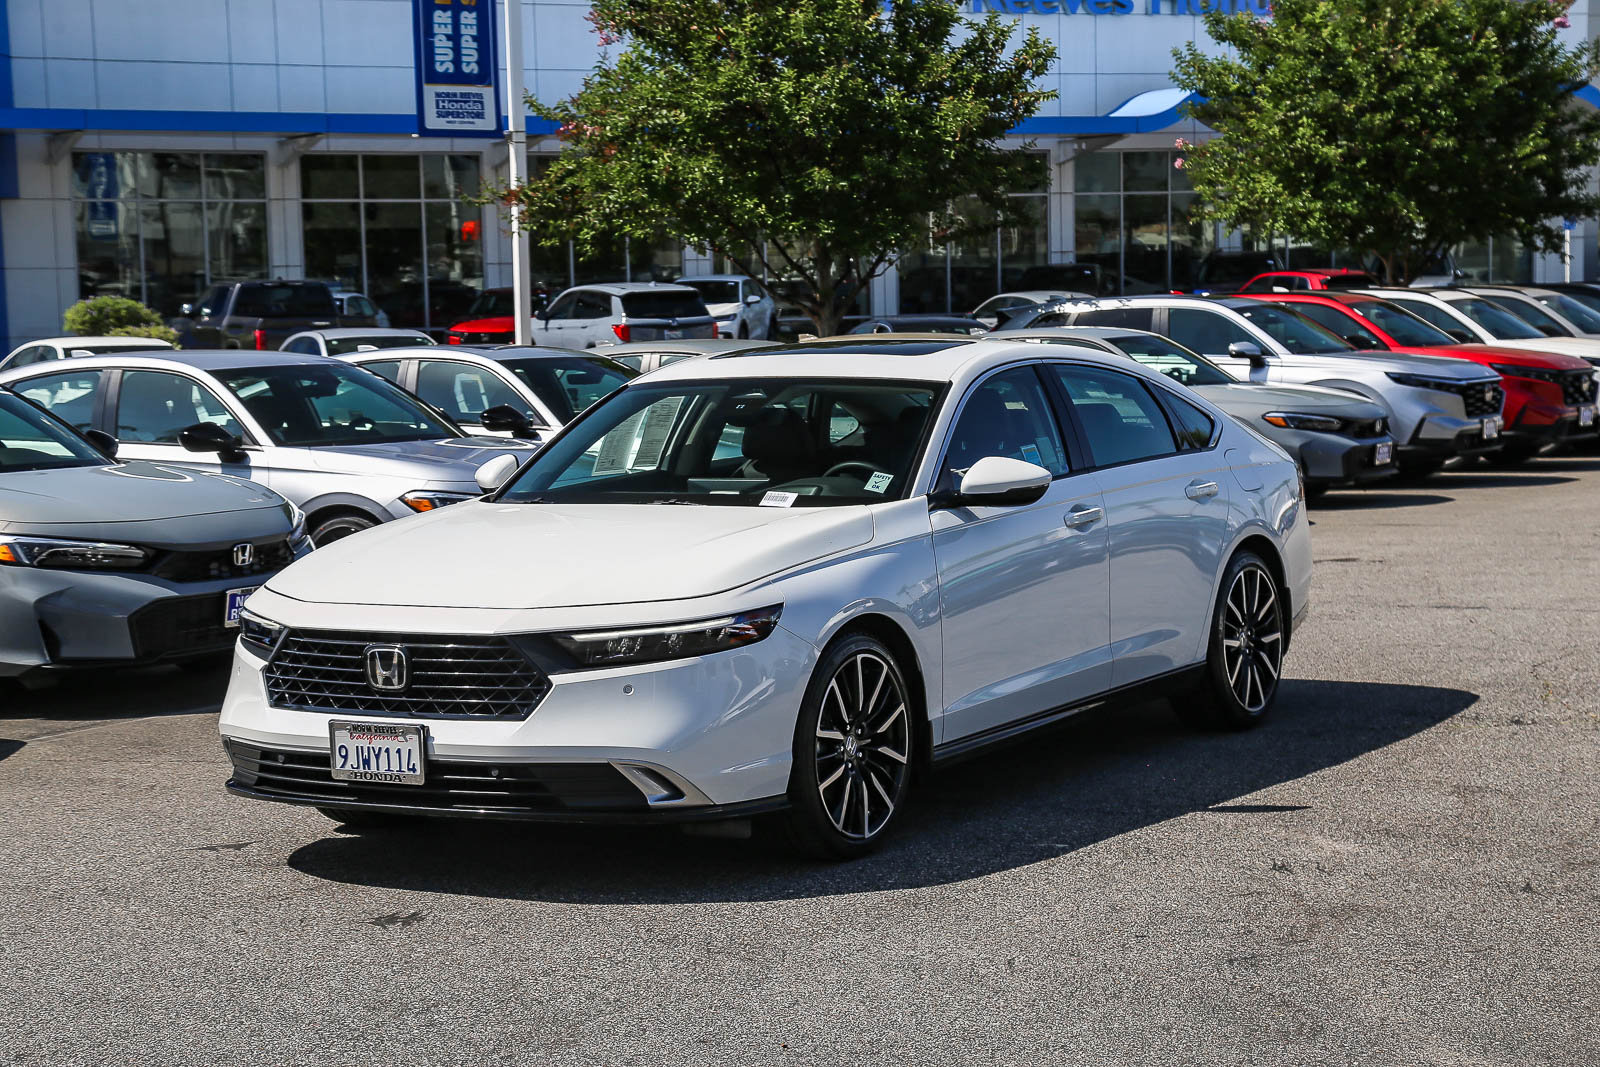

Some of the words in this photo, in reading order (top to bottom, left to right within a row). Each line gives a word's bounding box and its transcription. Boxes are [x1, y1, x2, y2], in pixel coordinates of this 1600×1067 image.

[433, 10, 454, 73] SUPER
[460, 10, 479, 74] SUPER
[438, 100, 482, 110] Honda
[351, 723, 372, 734] NORM
[374, 725, 397, 735] REEVES
[349, 732, 404, 744] California
[338, 744, 417, 774] 9JWY114
[353, 771, 402, 782] HONDA
